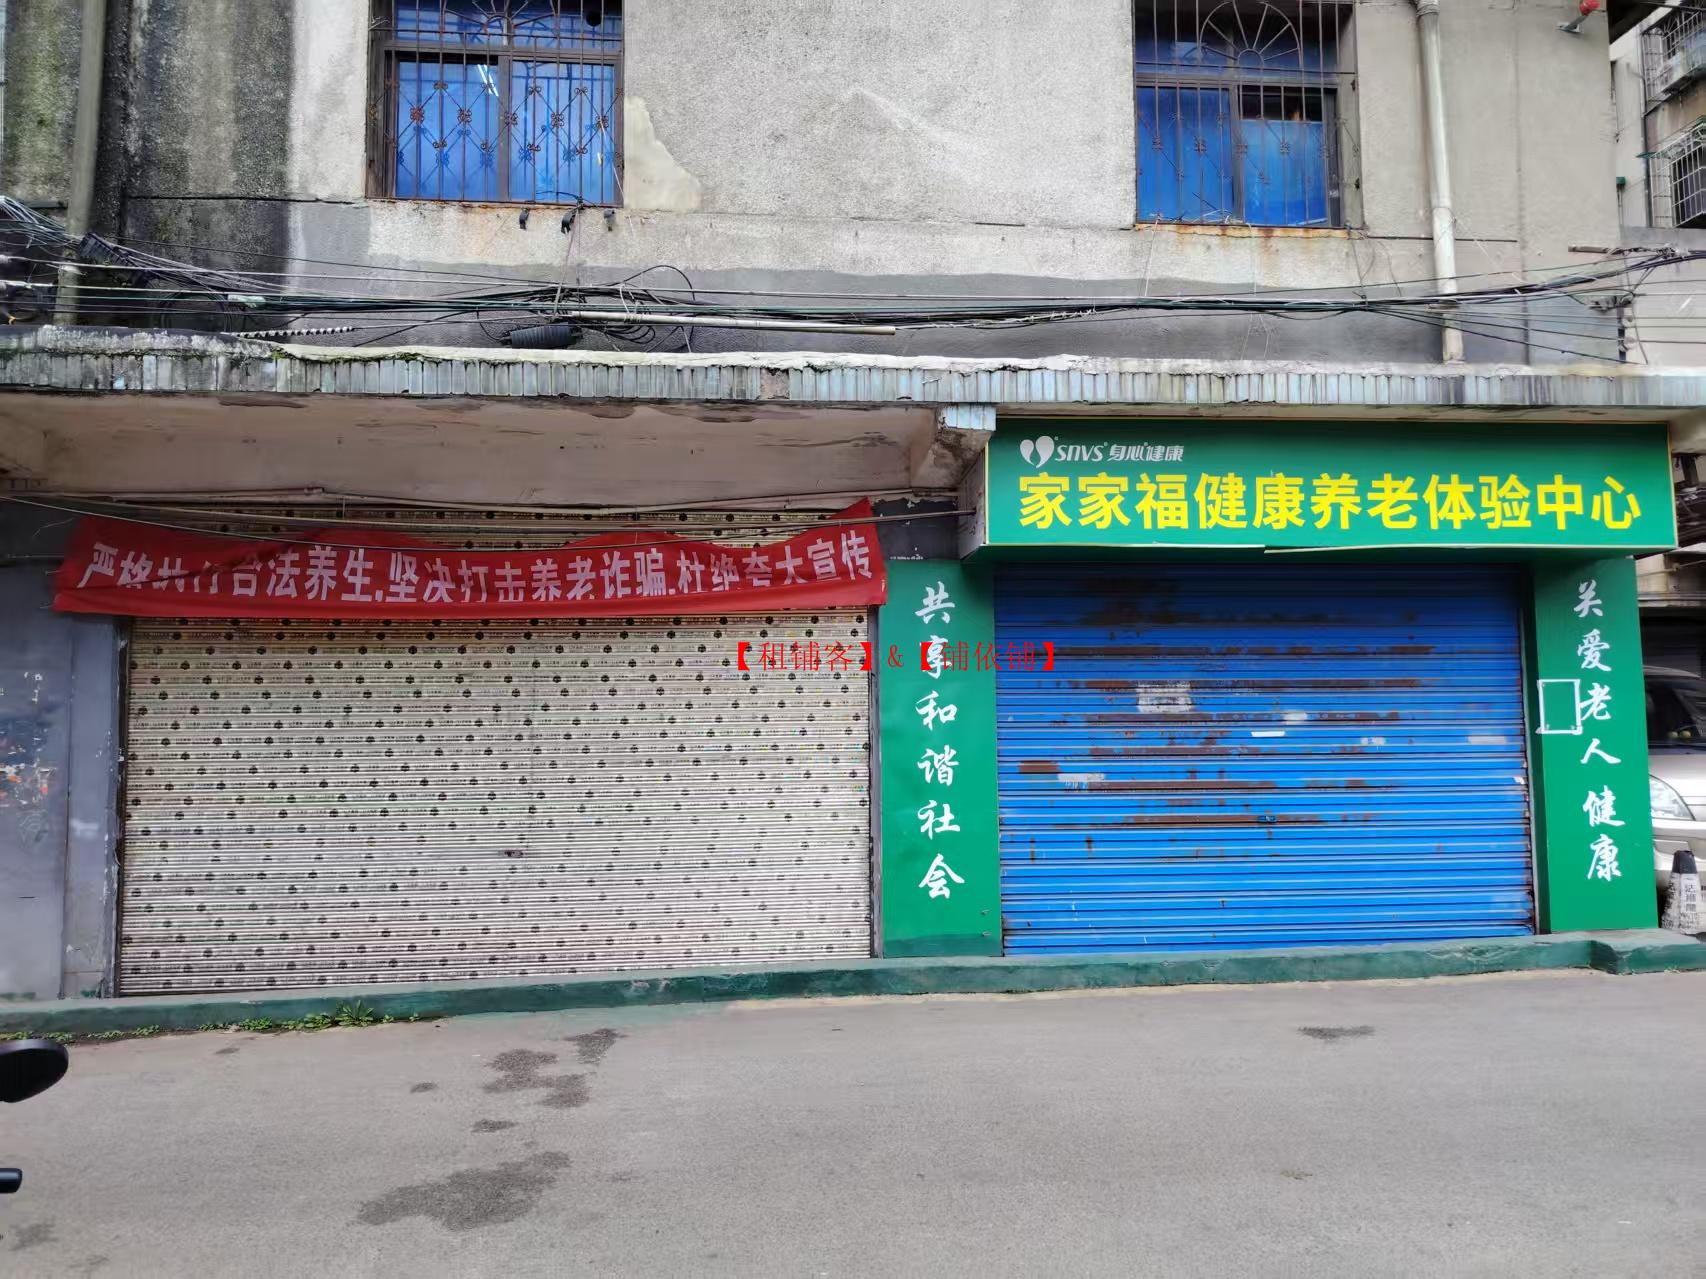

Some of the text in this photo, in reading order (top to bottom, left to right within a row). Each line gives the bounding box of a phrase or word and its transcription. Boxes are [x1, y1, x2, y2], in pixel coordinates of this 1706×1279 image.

[1018, 471, 1642, 530] 家家福健康养老体验中心
[1107, 443, 1184, 462] 身心健康
[914, 581, 965, 899] 共享和谐社会
[1573, 579, 1626, 882] 关爱老人健康
